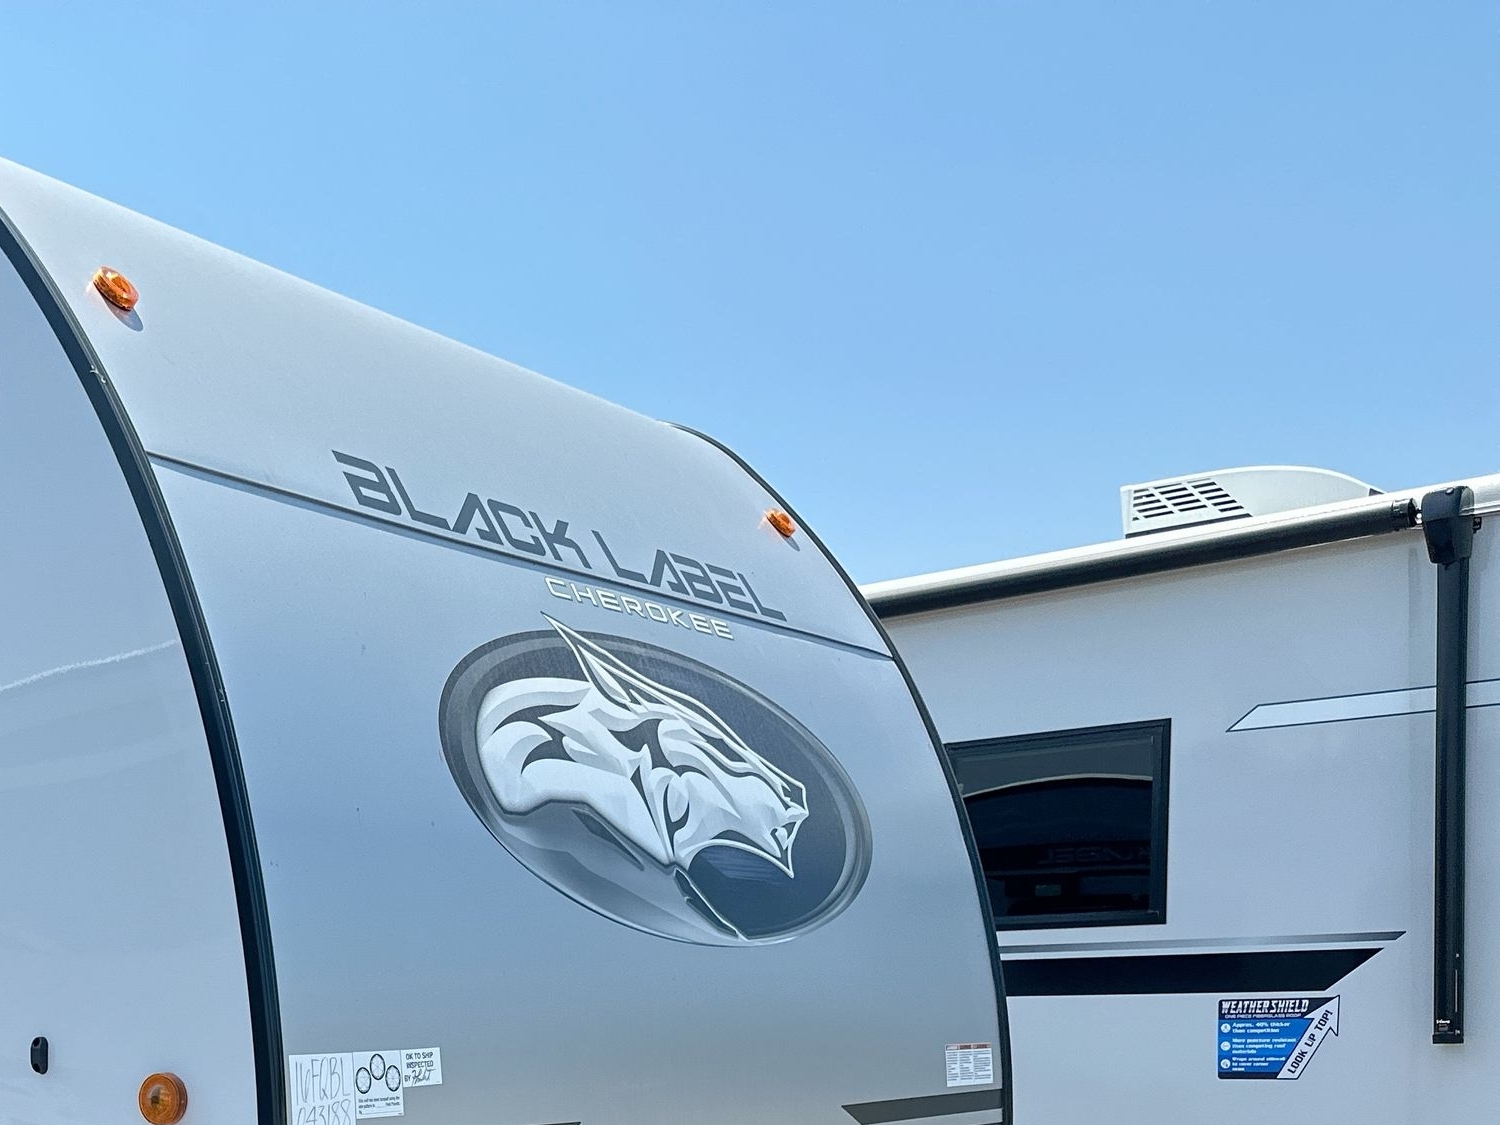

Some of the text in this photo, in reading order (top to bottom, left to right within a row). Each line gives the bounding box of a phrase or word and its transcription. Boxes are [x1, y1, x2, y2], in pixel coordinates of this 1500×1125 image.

[331, 449, 788, 622] BLACK LABEL
[543, 575, 735, 640] CHEROKEE
[406, 1060, 434, 1068] INSPECTED
[414, 1052, 421, 1060] TO
[421, 1051, 434, 1059] SHIP
[1287, 1009, 1334, 1074] LOOK UP TOP!
